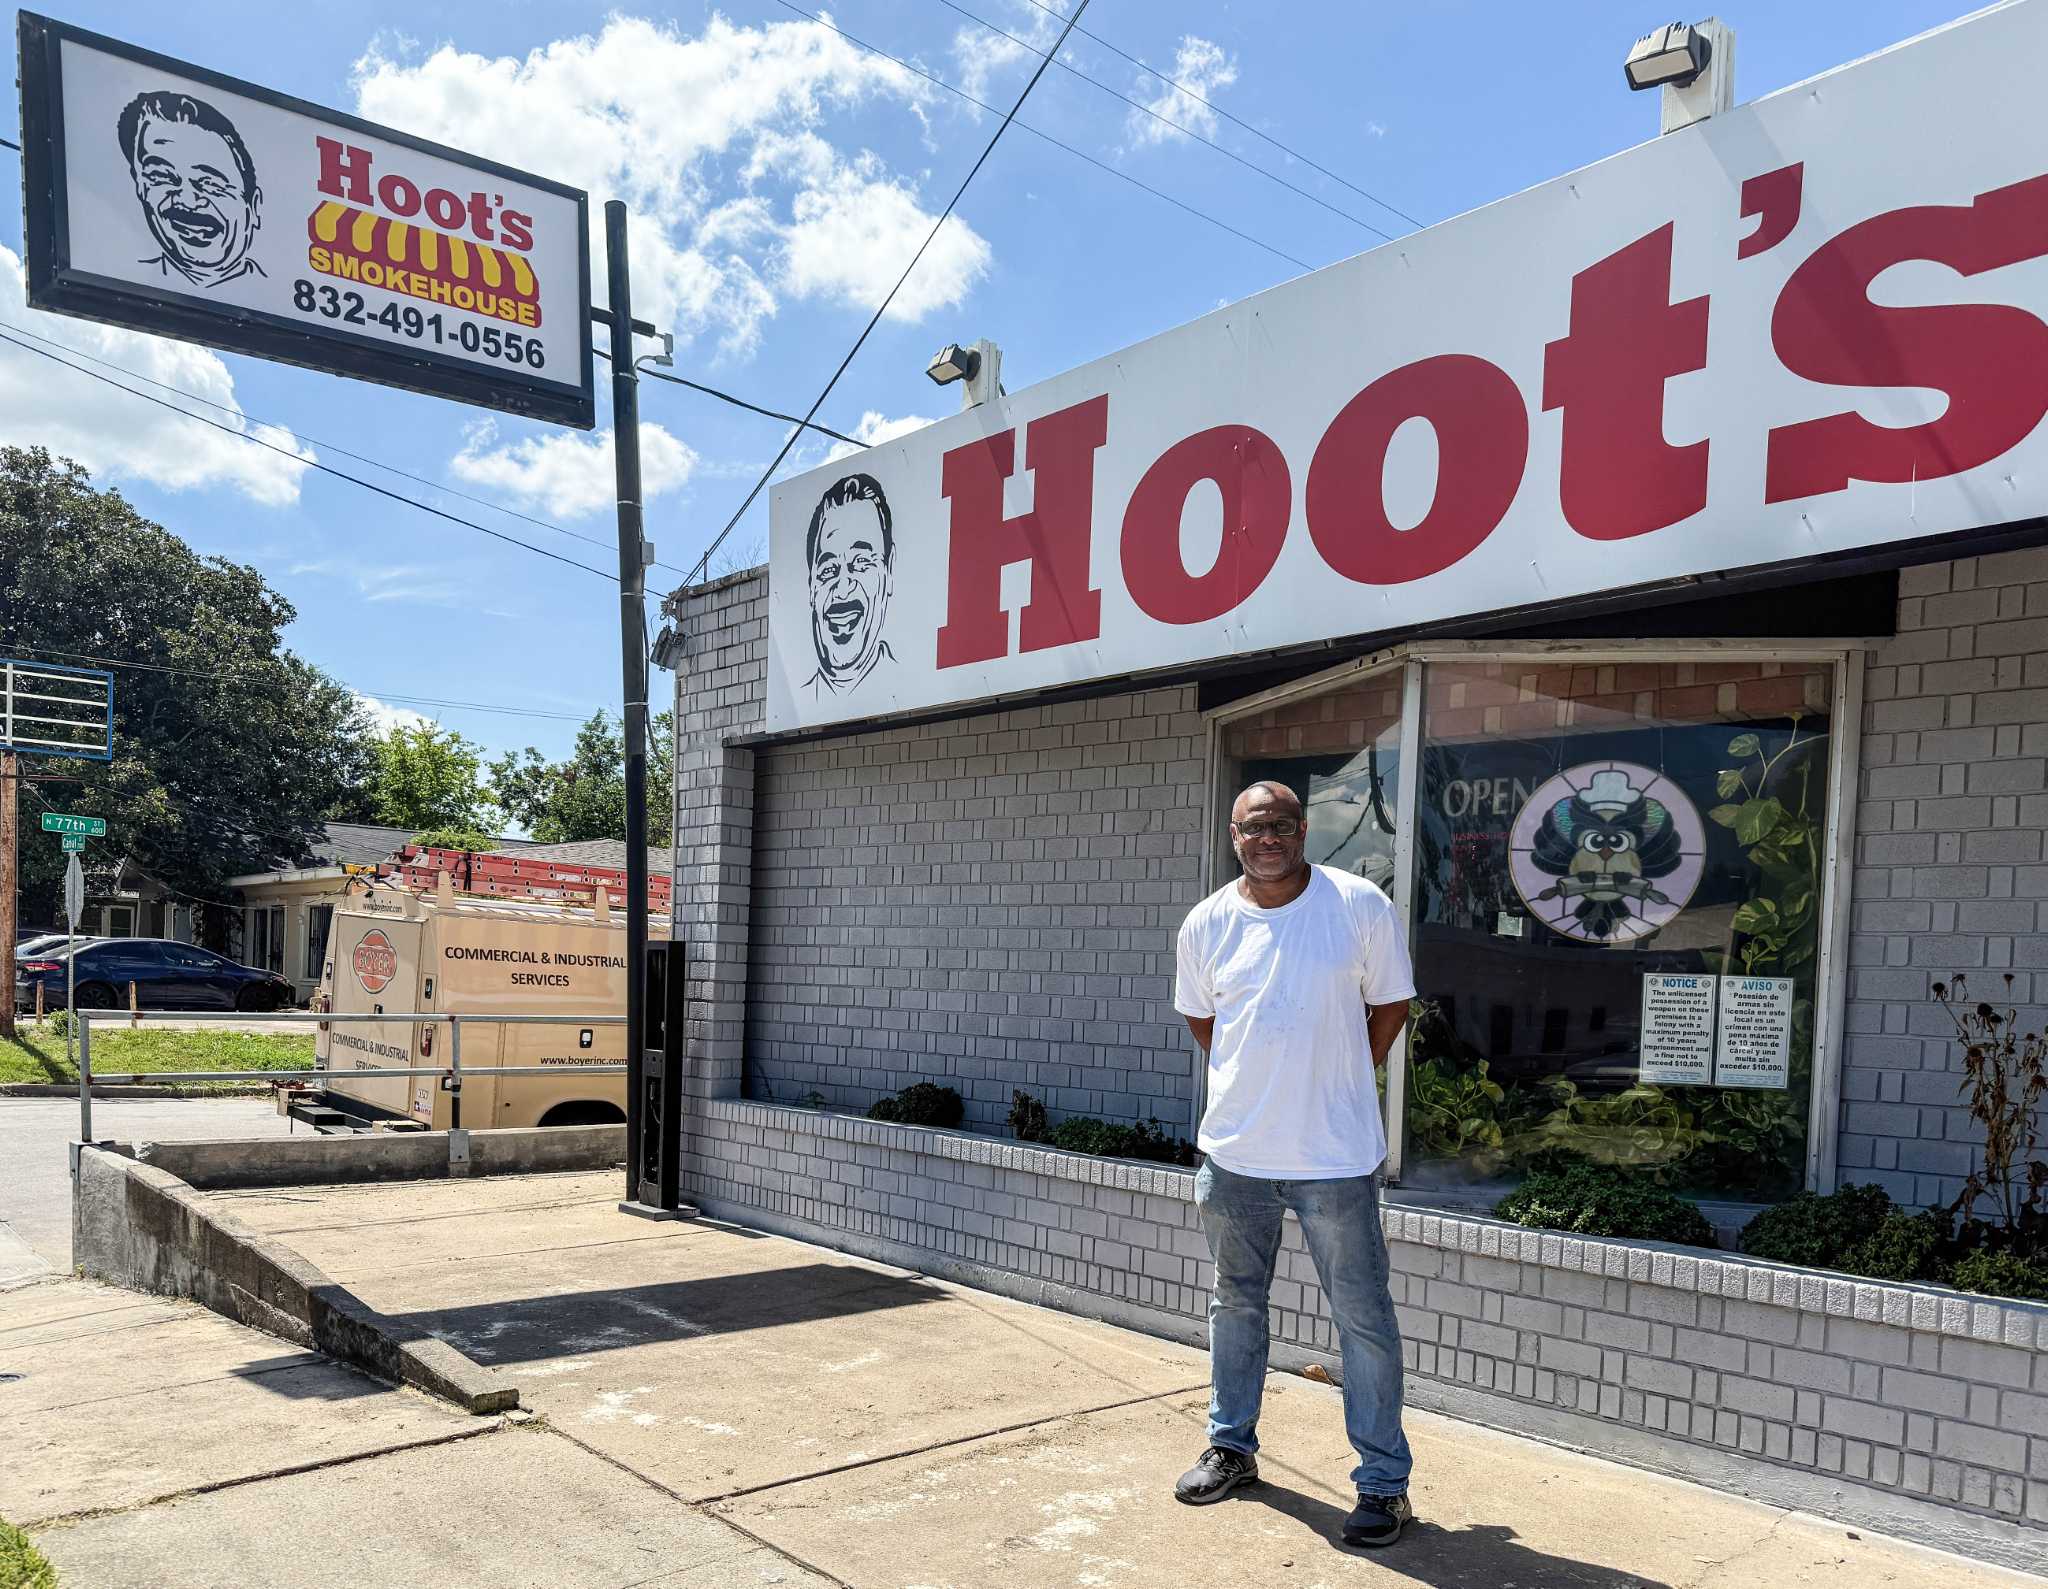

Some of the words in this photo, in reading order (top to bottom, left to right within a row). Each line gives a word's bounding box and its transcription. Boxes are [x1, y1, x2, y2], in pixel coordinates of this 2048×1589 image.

[316, 135, 533, 251] Hoot's
[310, 246, 536, 326] SMOKEHOUSE
[293, 279, 545, 368] 832-491-0556
[936, 161, 2048, 670] Hoot's
[56, 818, 86, 831] 77th
[444, 946, 538, 964] COMMERCIAL
[541, 952, 551, 964] &
[554, 953, 627, 968] INDUSTRIAL
[511, 973, 570, 987] SERVICES
[1662, 978, 1698, 988] NOTICE
[1741, 981, 1772, 991] AVISO
[1668, 990, 1707, 998] unlicensed
[1682, 1030, 1710, 1038] penalty
[332, 1032, 368, 1052] COMMERCIAL
[369, 1041, 374, 1053] &
[375, 1042, 409, 1062] INDUSTRIAL
[540, 1056, 628, 1066] www.boyerinc.com
